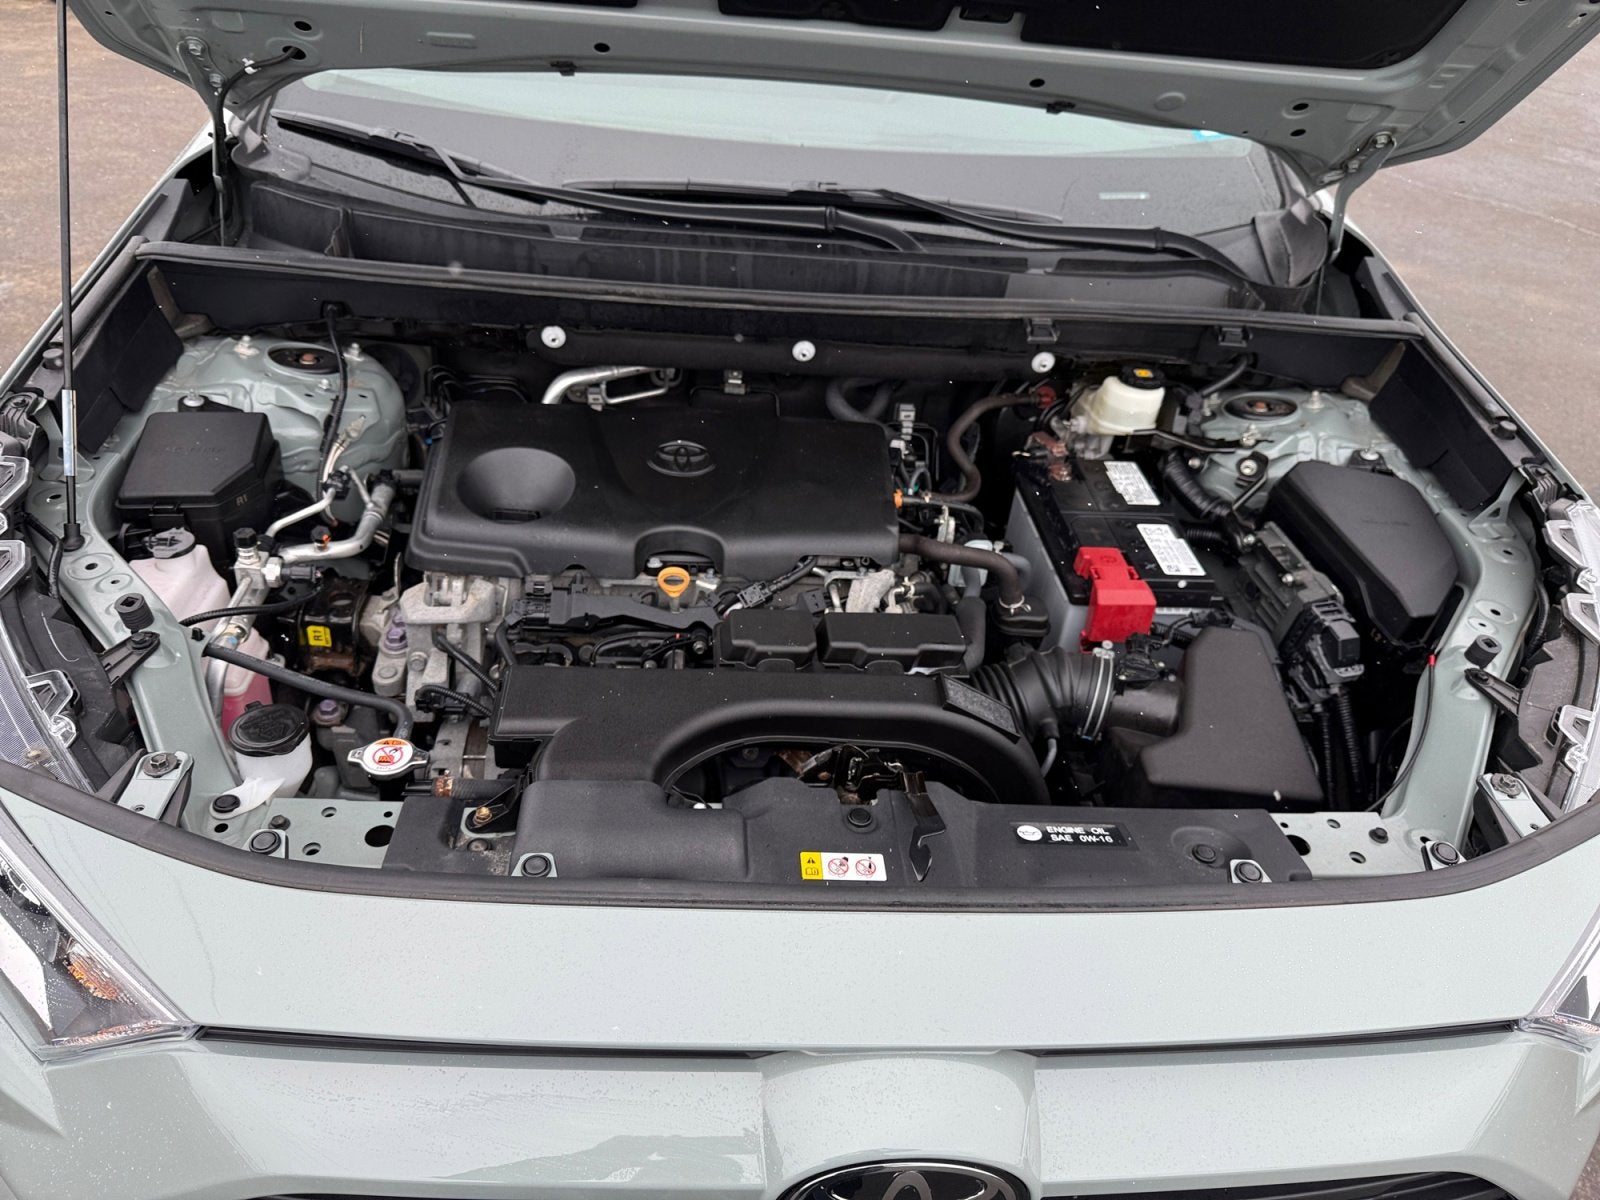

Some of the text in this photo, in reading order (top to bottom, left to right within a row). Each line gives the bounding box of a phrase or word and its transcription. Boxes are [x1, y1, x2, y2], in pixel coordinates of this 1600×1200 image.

[235, 494, 248, 506] R1
[1045, 825, 1110, 835] ENGINE OIL
[1050, 834, 1074, 842] SAE
